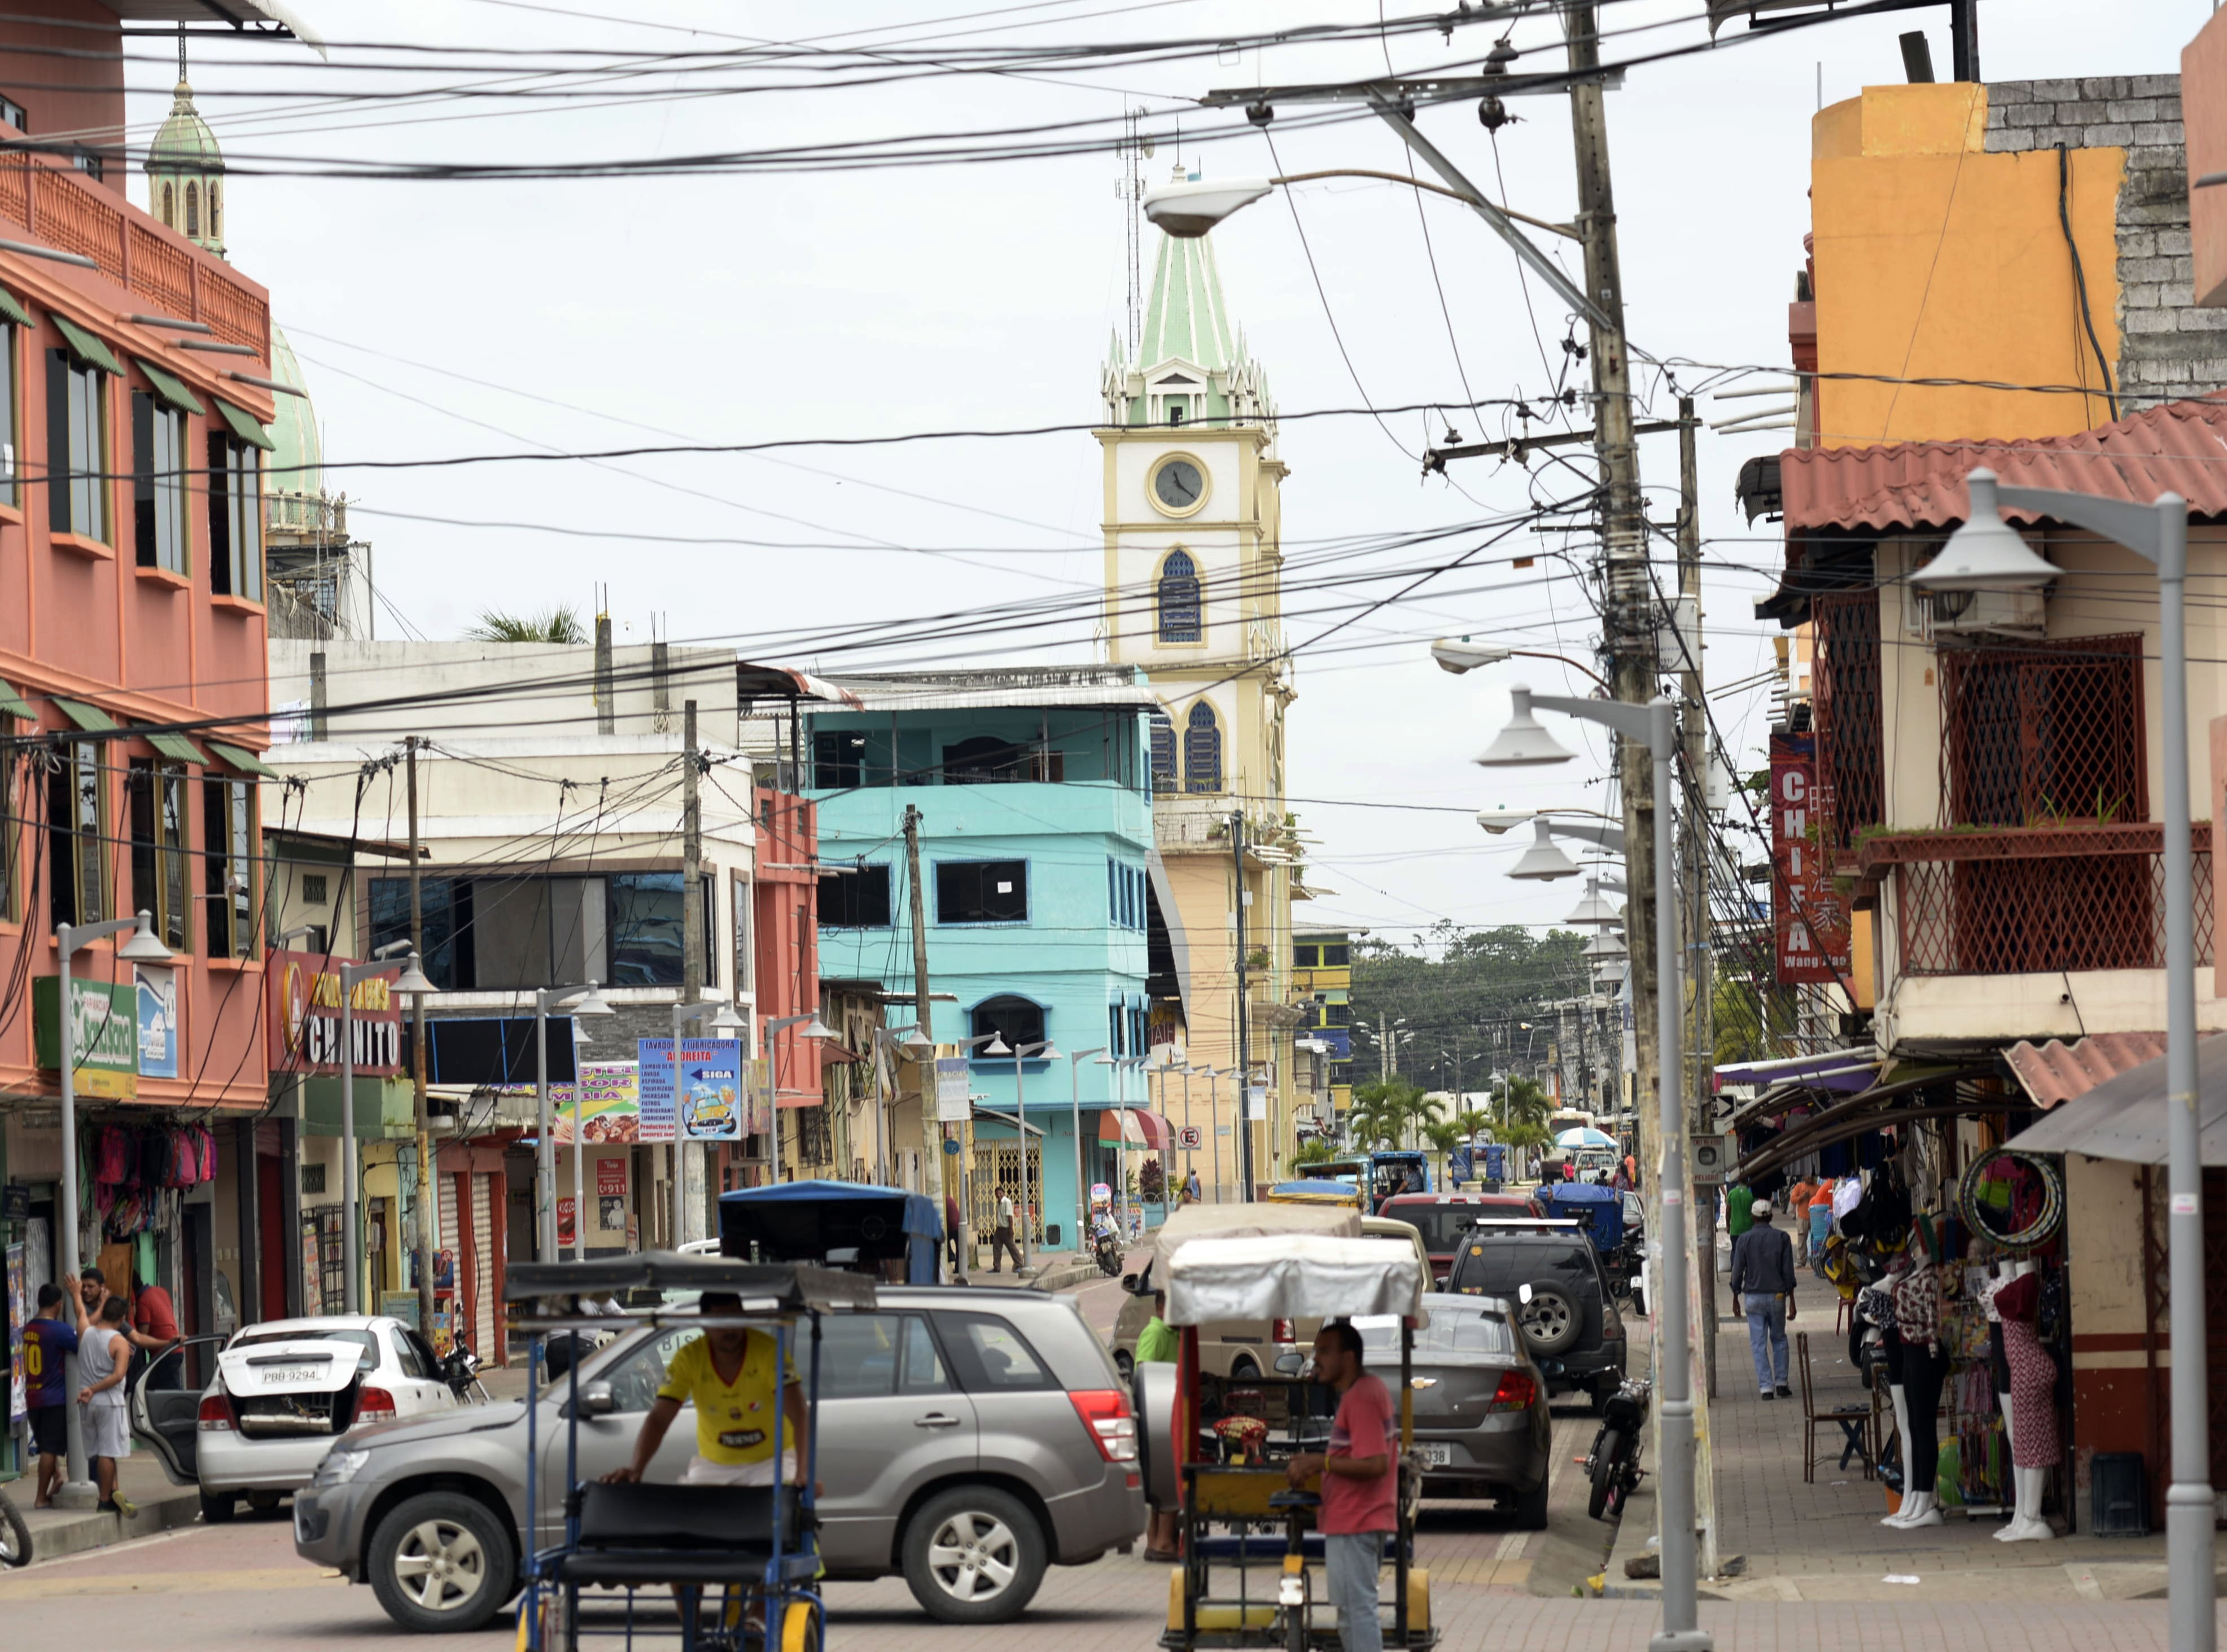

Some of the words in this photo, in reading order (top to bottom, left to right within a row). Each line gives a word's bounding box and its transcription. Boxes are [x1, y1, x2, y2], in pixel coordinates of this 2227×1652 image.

[1782, 772, 1810, 952] CHIFA
[1784, 956, 1818, 968] Wang
[309, 1015, 397, 1066] CHNITO
[645, 1041, 675, 1049] LAVADOR
[702, 1071, 732, 1079] SIGA
[608, 1184, 625, 1193] 911
[23, 1343, 42, 1375] 10
[264, 1371, 316, 1382] PBB-9294
